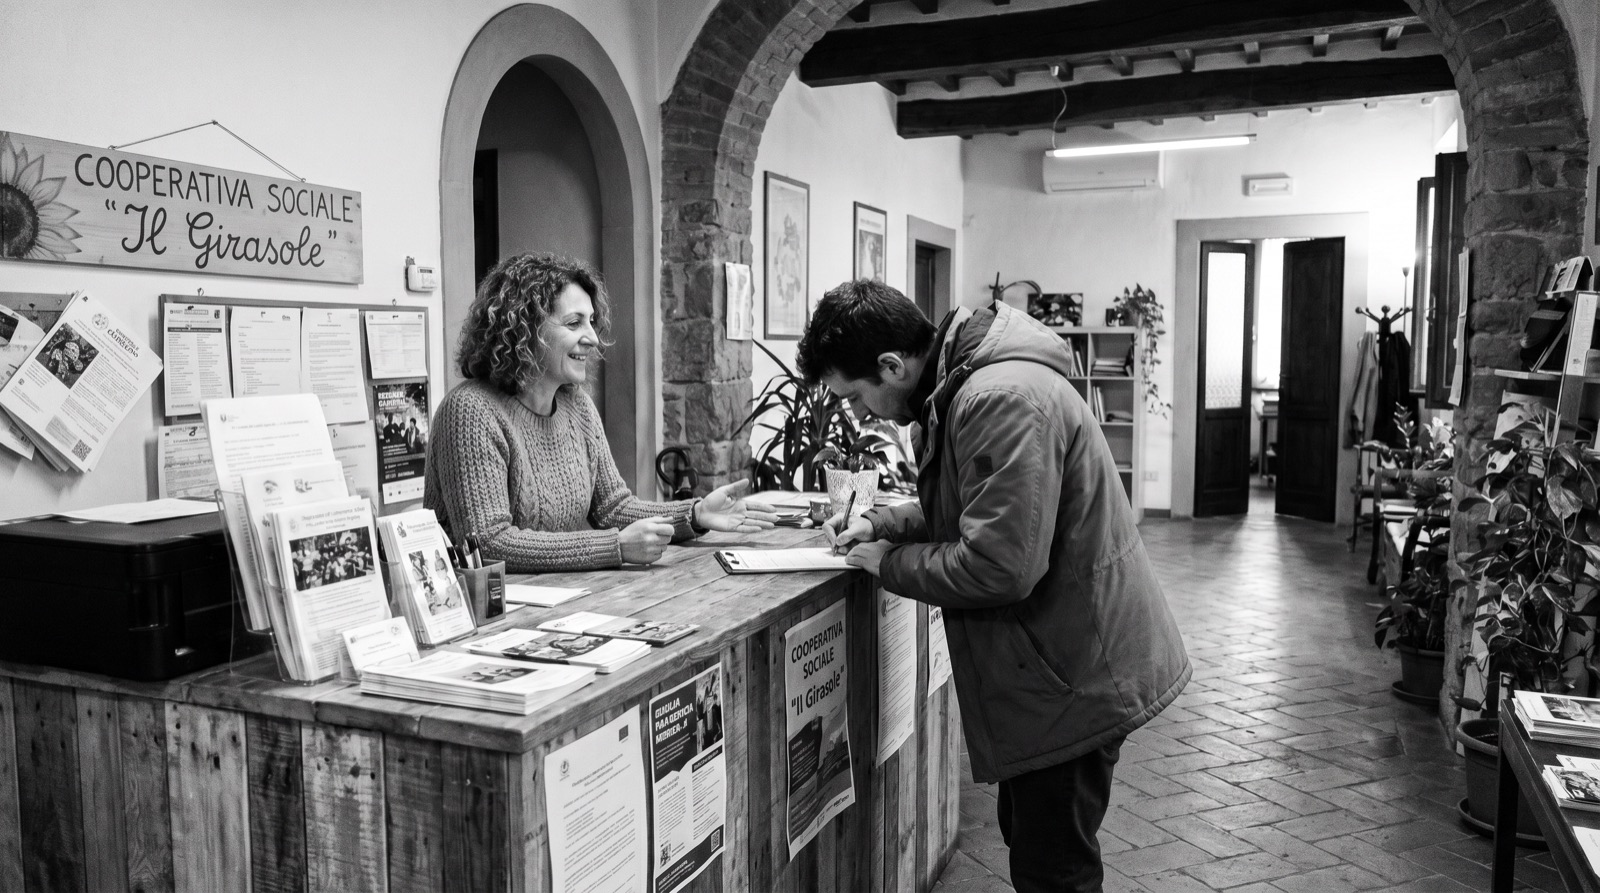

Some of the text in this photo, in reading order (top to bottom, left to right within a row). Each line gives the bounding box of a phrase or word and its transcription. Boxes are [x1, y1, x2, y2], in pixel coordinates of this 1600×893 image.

[74, 153, 354, 224] COOPERATIVA SOCIALE
[791, 620, 844, 664] COOPERATIVA
[803, 646, 835, 680] SOCIALE
